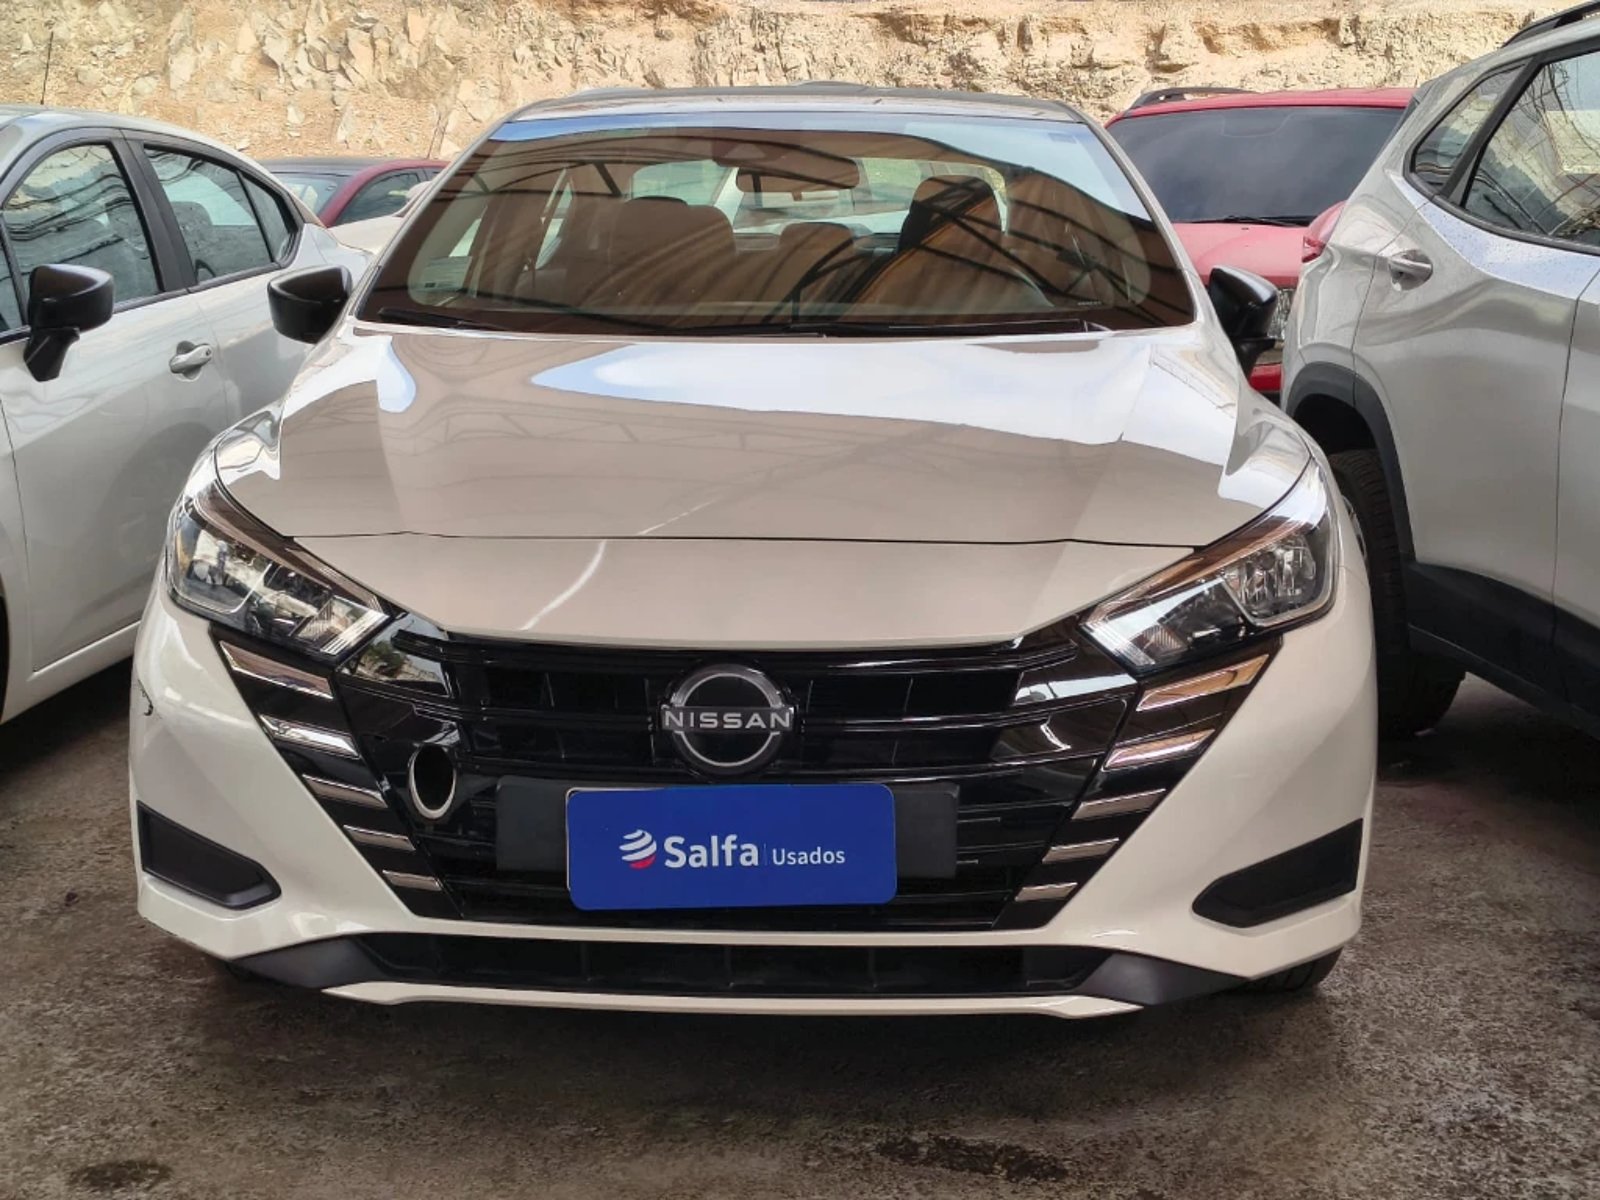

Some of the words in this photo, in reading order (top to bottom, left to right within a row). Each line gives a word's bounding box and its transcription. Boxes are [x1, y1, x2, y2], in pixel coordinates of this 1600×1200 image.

[664, 711, 790, 729] NISSAN
[663, 834, 759, 868] Salfa
[772, 847, 846, 866] Usados
